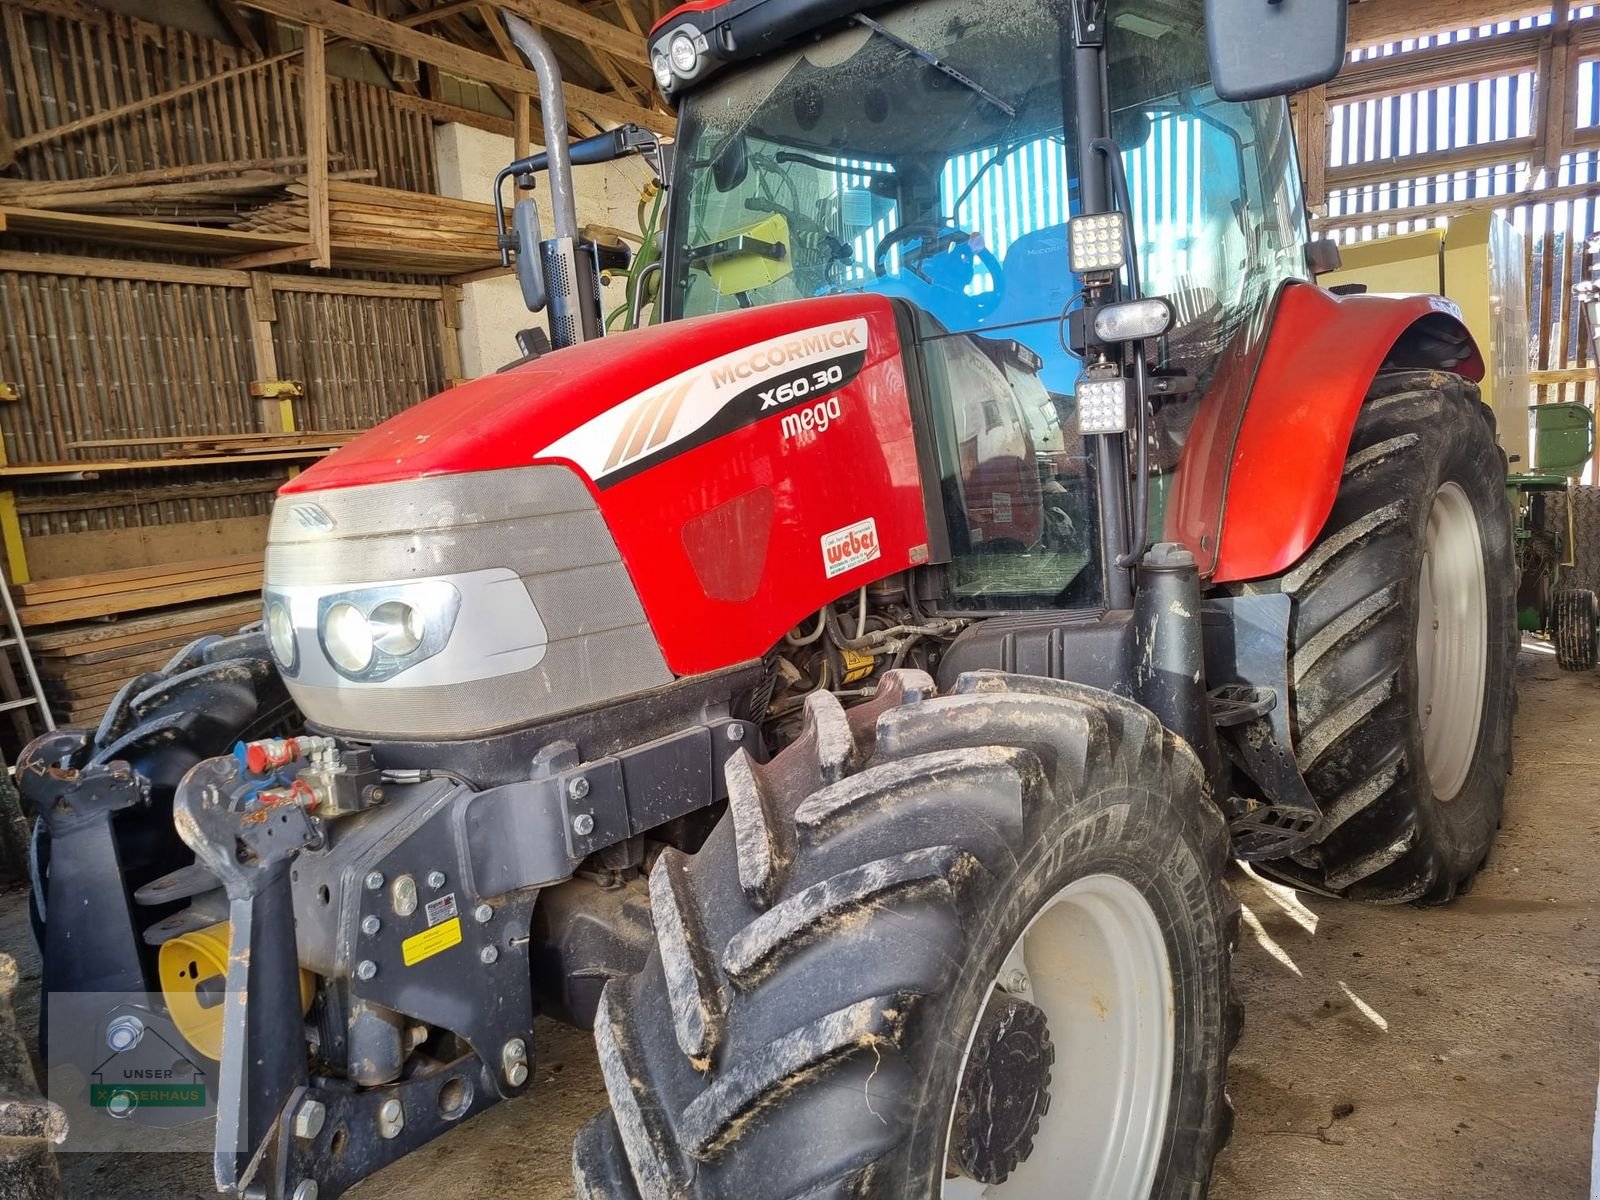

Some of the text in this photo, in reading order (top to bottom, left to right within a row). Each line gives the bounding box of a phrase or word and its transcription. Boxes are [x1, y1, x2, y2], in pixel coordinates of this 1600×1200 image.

[710, 327, 861, 390] McCORMICK
[757, 365, 843, 411] X60.30
[781, 396, 841, 439] mega
[827, 531, 874, 564] weber
